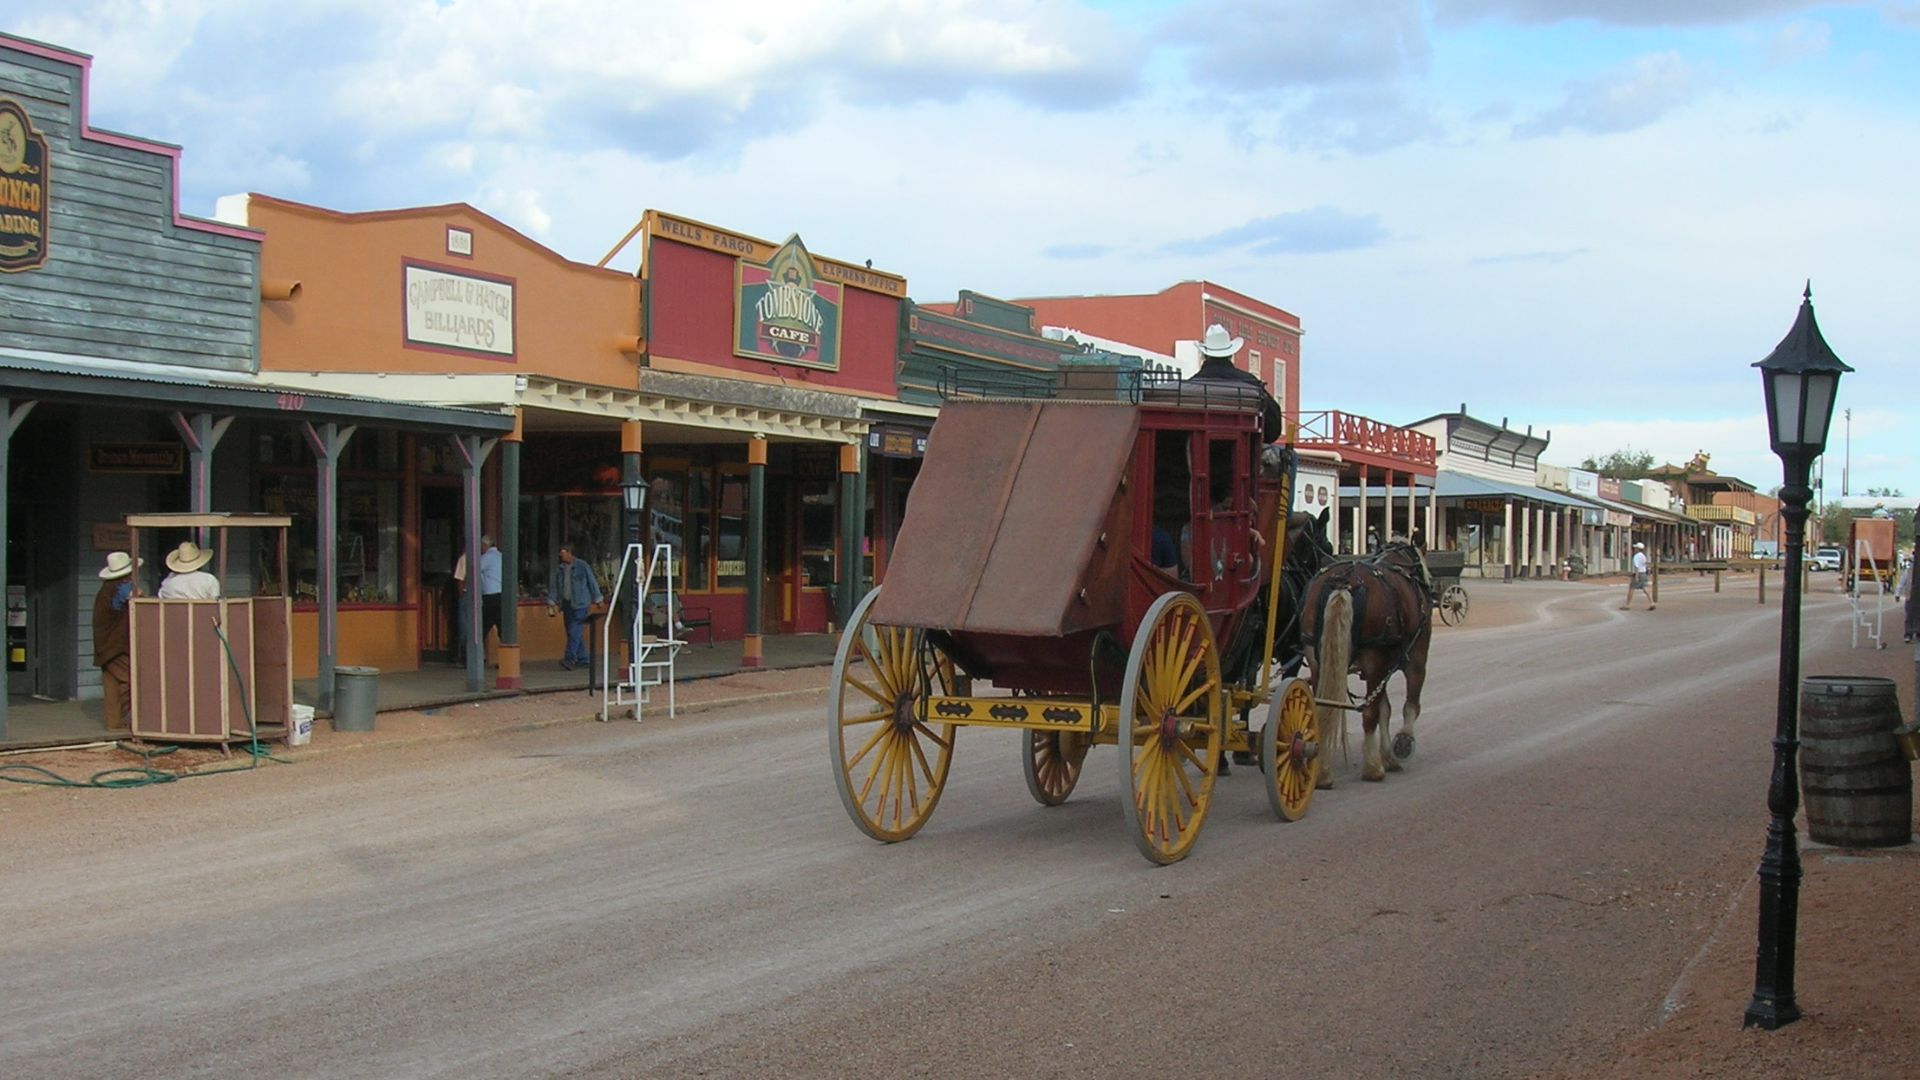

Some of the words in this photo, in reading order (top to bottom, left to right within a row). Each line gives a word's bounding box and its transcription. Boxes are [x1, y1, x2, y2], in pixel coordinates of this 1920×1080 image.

[661, 219, 702, 241] WELLS
[712, 233, 753, 255] FARGO
[823, 263, 865, 284] EXPRESS
[867, 274, 898, 292] OFFICE
[409, 278, 464, 310] CAMPBELL
[476, 284, 510, 320] HATCH
[755, 285, 824, 335] TOMBSTONE
[425, 310, 495, 348] BILLIARDS
[769, 327, 810, 343] CAFE
[277, 394, 304, 411] 410
